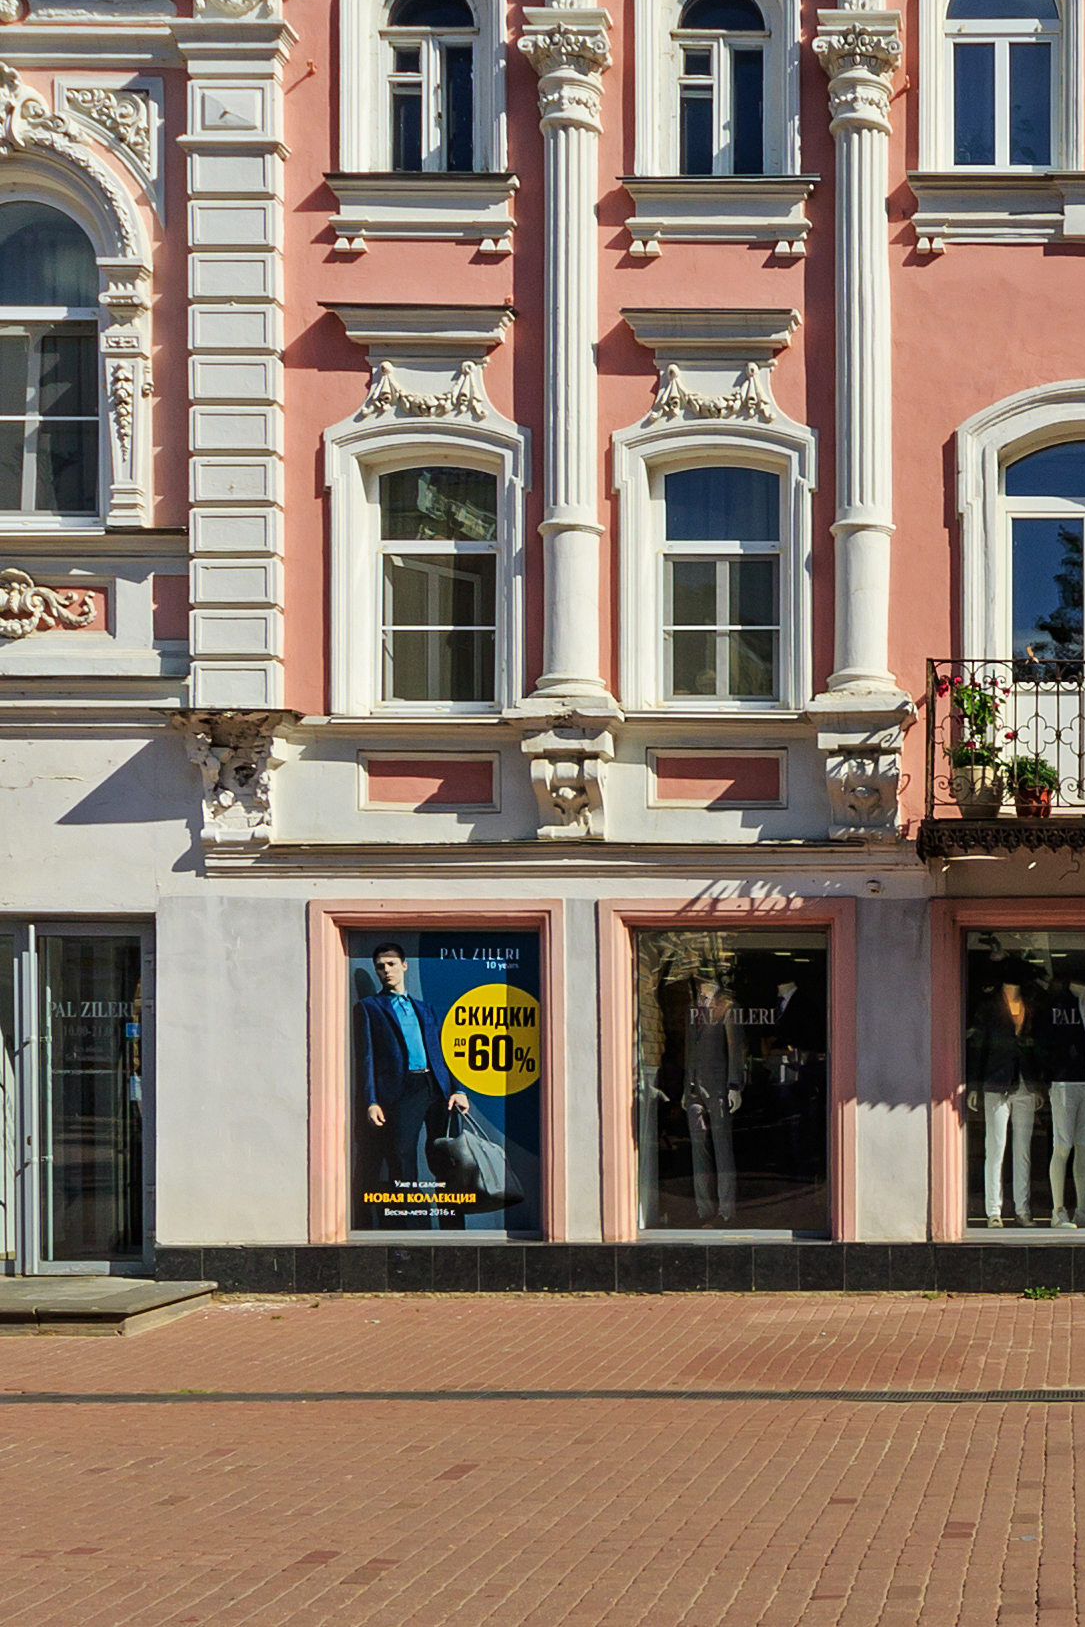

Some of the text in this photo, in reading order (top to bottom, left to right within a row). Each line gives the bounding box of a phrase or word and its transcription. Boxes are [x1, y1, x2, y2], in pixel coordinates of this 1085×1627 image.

[440, 948, 519, 960] PAL ZILERI
[486, 961, 497, 969] 10
[80, 1002, 135, 1018] ZILERI
[689, 1008, 719, 1025] PAL
[1052, 1007, 1081, 1025] PAL
[454, 1005, 536, 1030] СКИДКИ
[363, 1192, 477, 1204] НОВАЯ КОЛЛЕКЦИЯ
[429, 1208, 450, 1216] 2016
